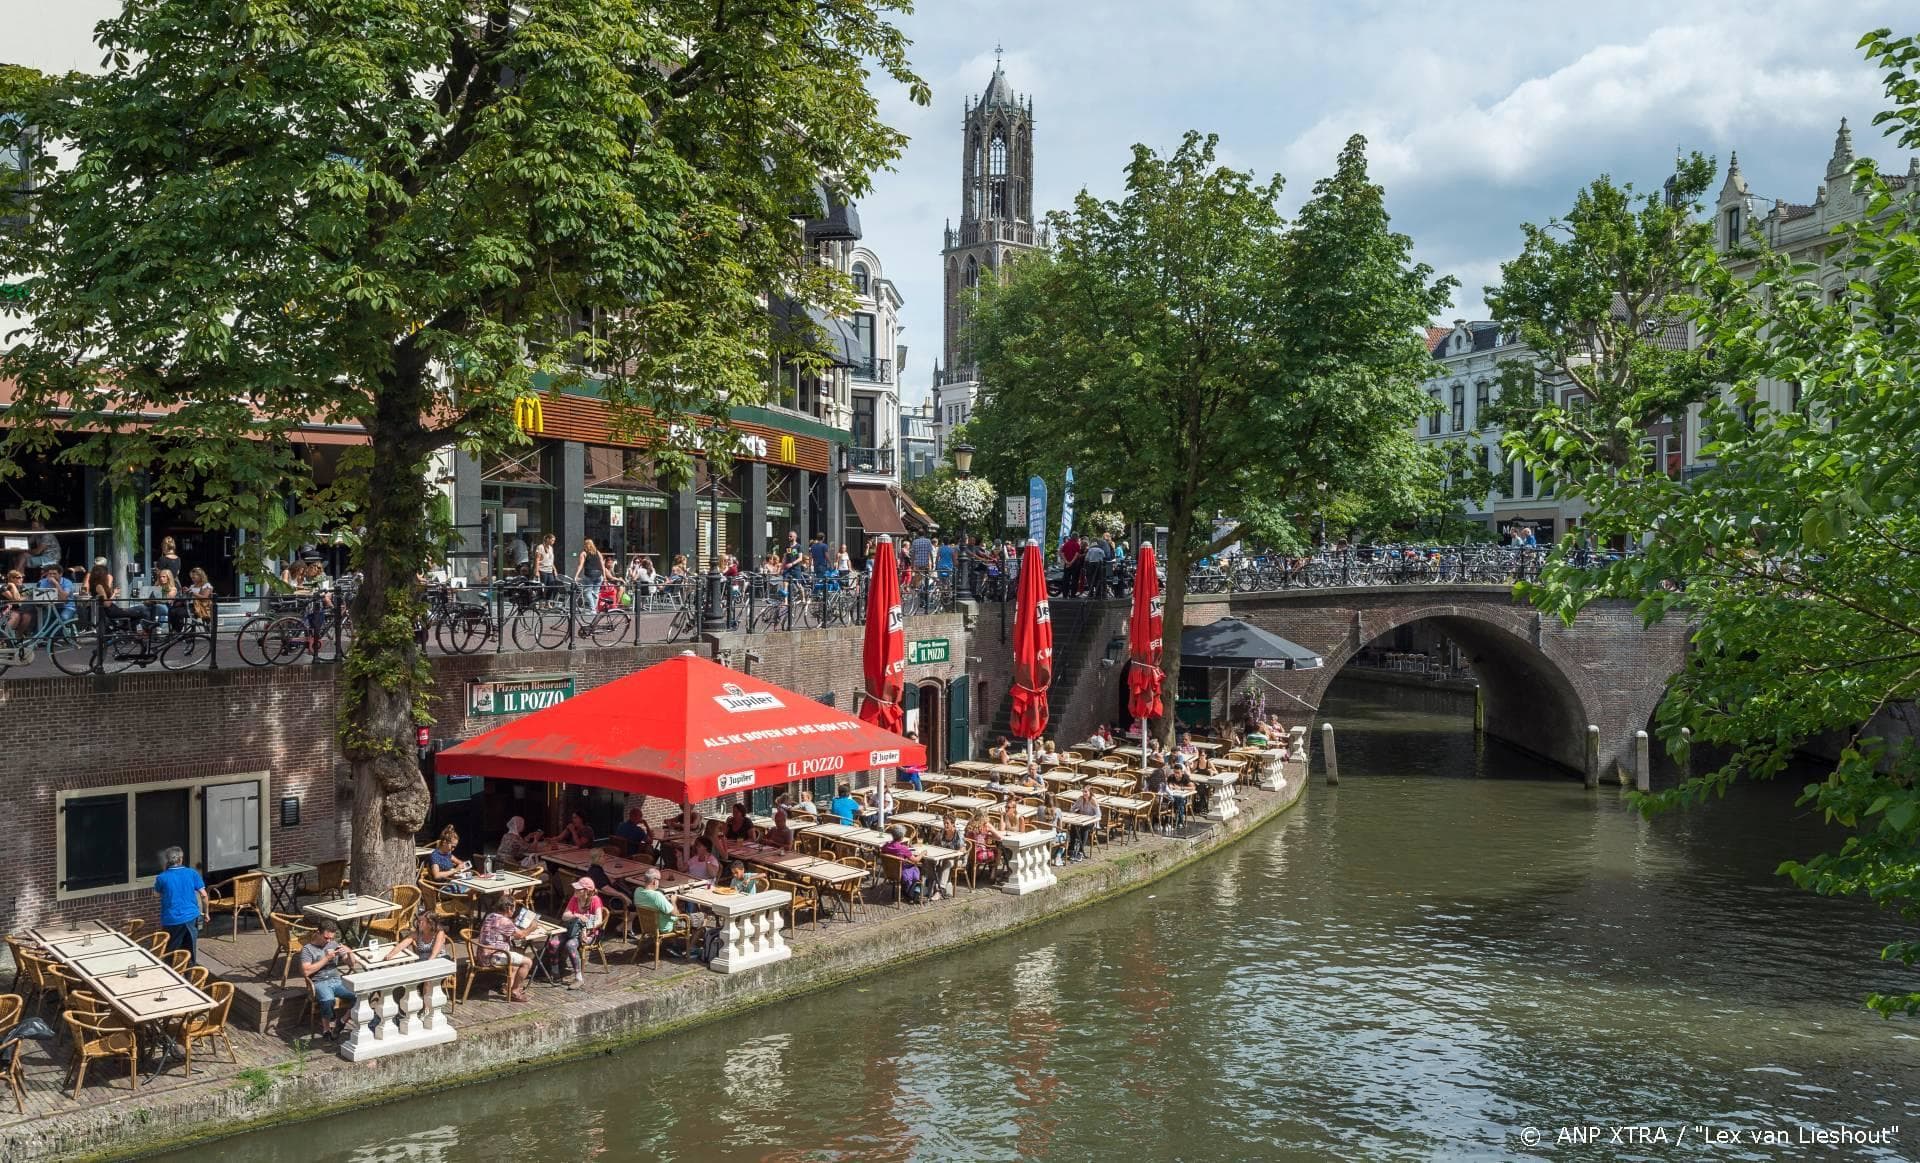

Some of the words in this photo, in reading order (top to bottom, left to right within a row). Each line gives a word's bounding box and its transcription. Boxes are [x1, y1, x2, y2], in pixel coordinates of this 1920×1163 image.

[496, 682, 529, 693] Pizzeria
[531, 680, 572, 691] Ristorante
[503, 693, 518, 712] IL
[520, 690, 565, 710] POZZO
[723, 694, 773, 709] Jupiler
[703, 736, 730, 748] ALS
[727, 733, 746, 745] IK
[742, 728, 785, 742] BOVEN
[782, 726, 799, 737] OP
[800, 723, 818, 734] DE
[836, 720, 861, 731] STA
[878, 751, 898, 762] Jupiler
[787, 762, 801, 777] IL
[803, 755, 844, 775] POZZO
[728, 774, 754, 786] Jupiler
